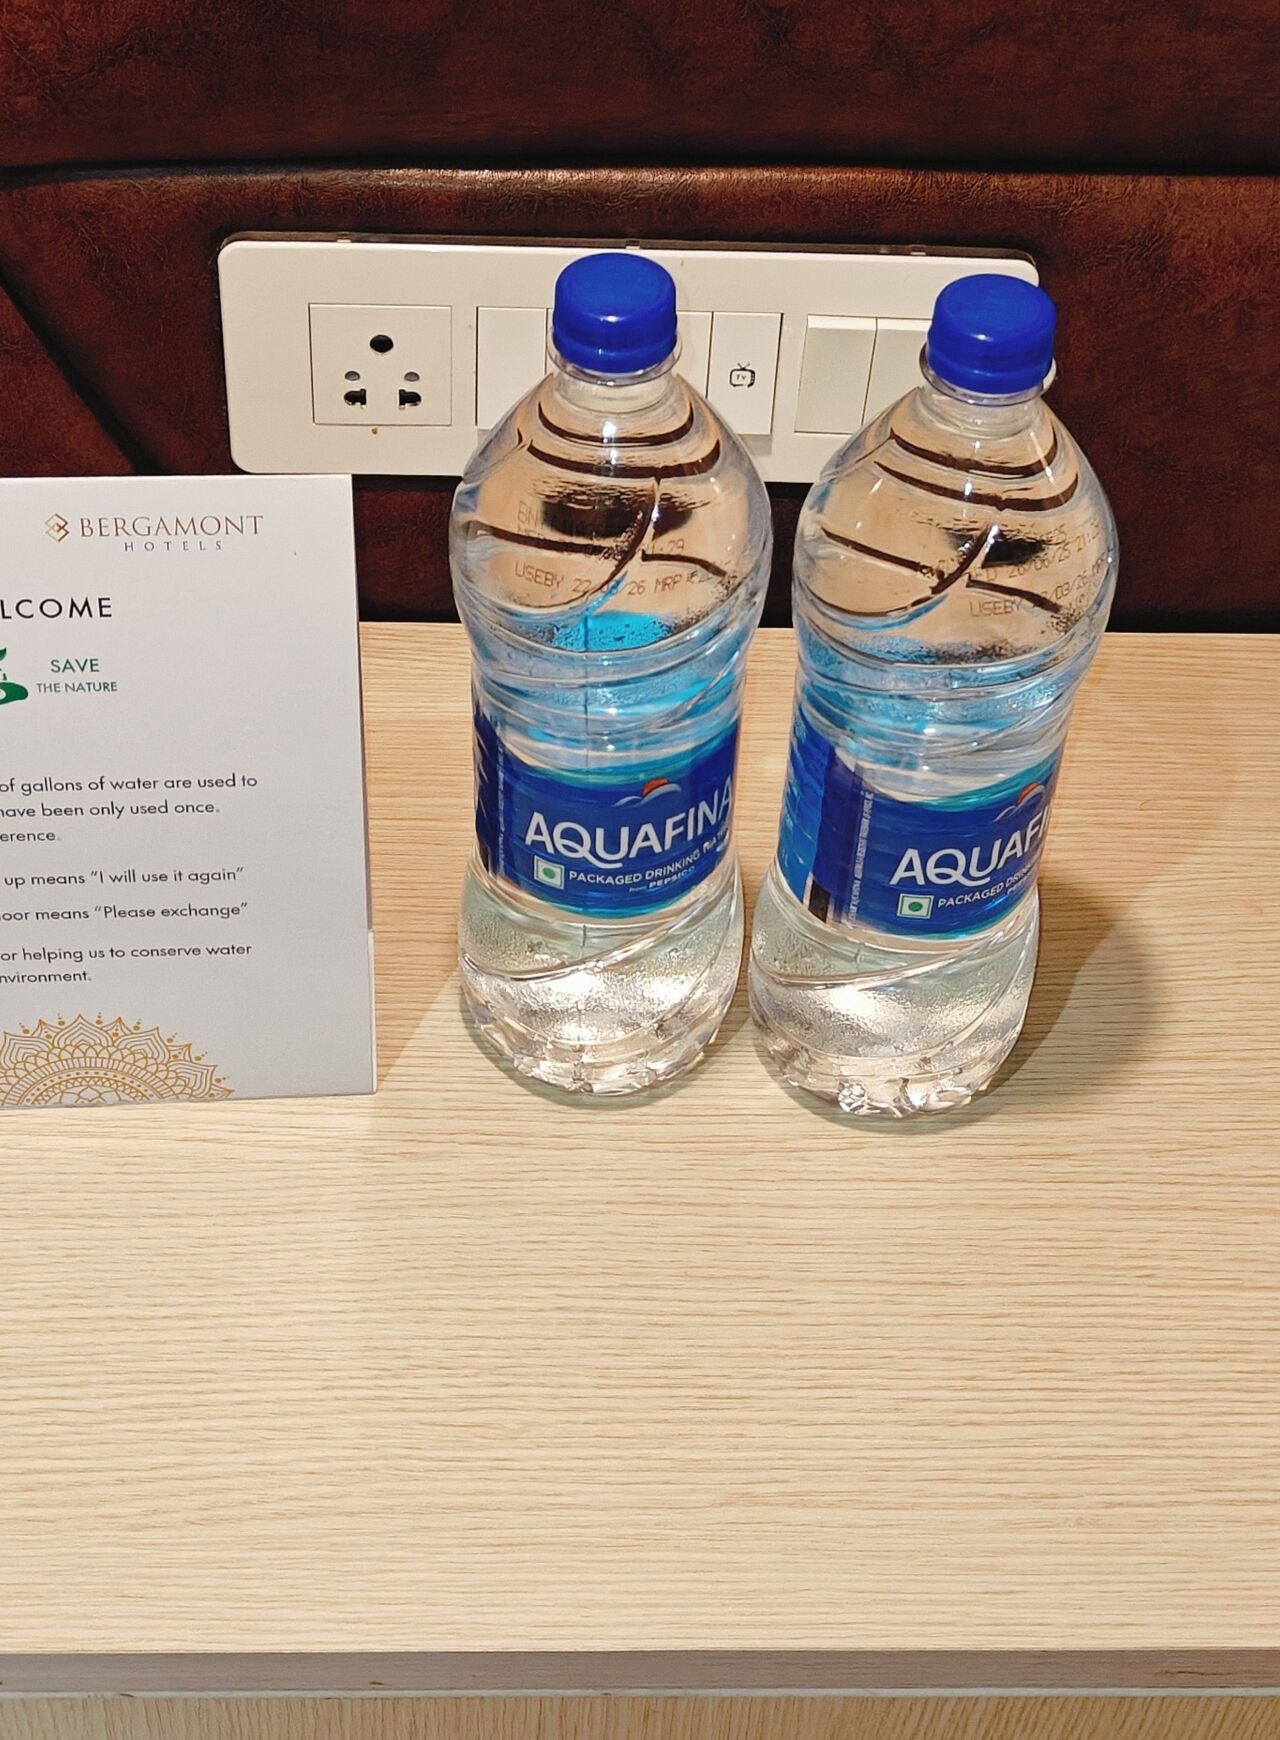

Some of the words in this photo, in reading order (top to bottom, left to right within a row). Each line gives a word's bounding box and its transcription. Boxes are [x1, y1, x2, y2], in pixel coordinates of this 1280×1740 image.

[79, 515, 264, 538] BERGAMONT
[123, 540, 222, 552] HOTELS
[514, 562, 564, 589] USEBY
[653, 573, 683, 594] MRP
[968, 599, 1021, 618] USEBY
[50, 658, 100, 674] SAVE
[36, 682, 62, 694] THE
[64, 681, 119, 694] NATURE
[20, 776, 83, 797] gallons
[87, 775, 106, 791] of
[109, 776, 160, 791] water
[163, 779, 193, 789] are
[197, 771, 237, 789] used
[240, 774, 258, 788] to
[40, 801, 85, 817] been
[88, 800, 125, 820] only
[129, 798, 169, 815] used
[173, 803, 220, 814] once.
[524, 774, 732, 869] AQUAFINA
[888, 804, 1050, 888] AQUAFI
[569, 870, 643, 886] PACKAGED
[645, 849, 701, 881] DRINKING
[3, 876, 26, 890] up
[30, 874, 86, 886] means
[108, 868, 137, 884] will
[141, 873, 169, 883] use
[172, 869, 184, 883] it
[936, 881, 1005, 909] PACKAGED
[34, 910, 90, 921] means
[21, 946, 84, 965] helping
[88, 949, 106, 959] us
[108, 946, 126, 959] to
[130, 947, 202, 958] conserve
[205, 943, 253, 956] water
